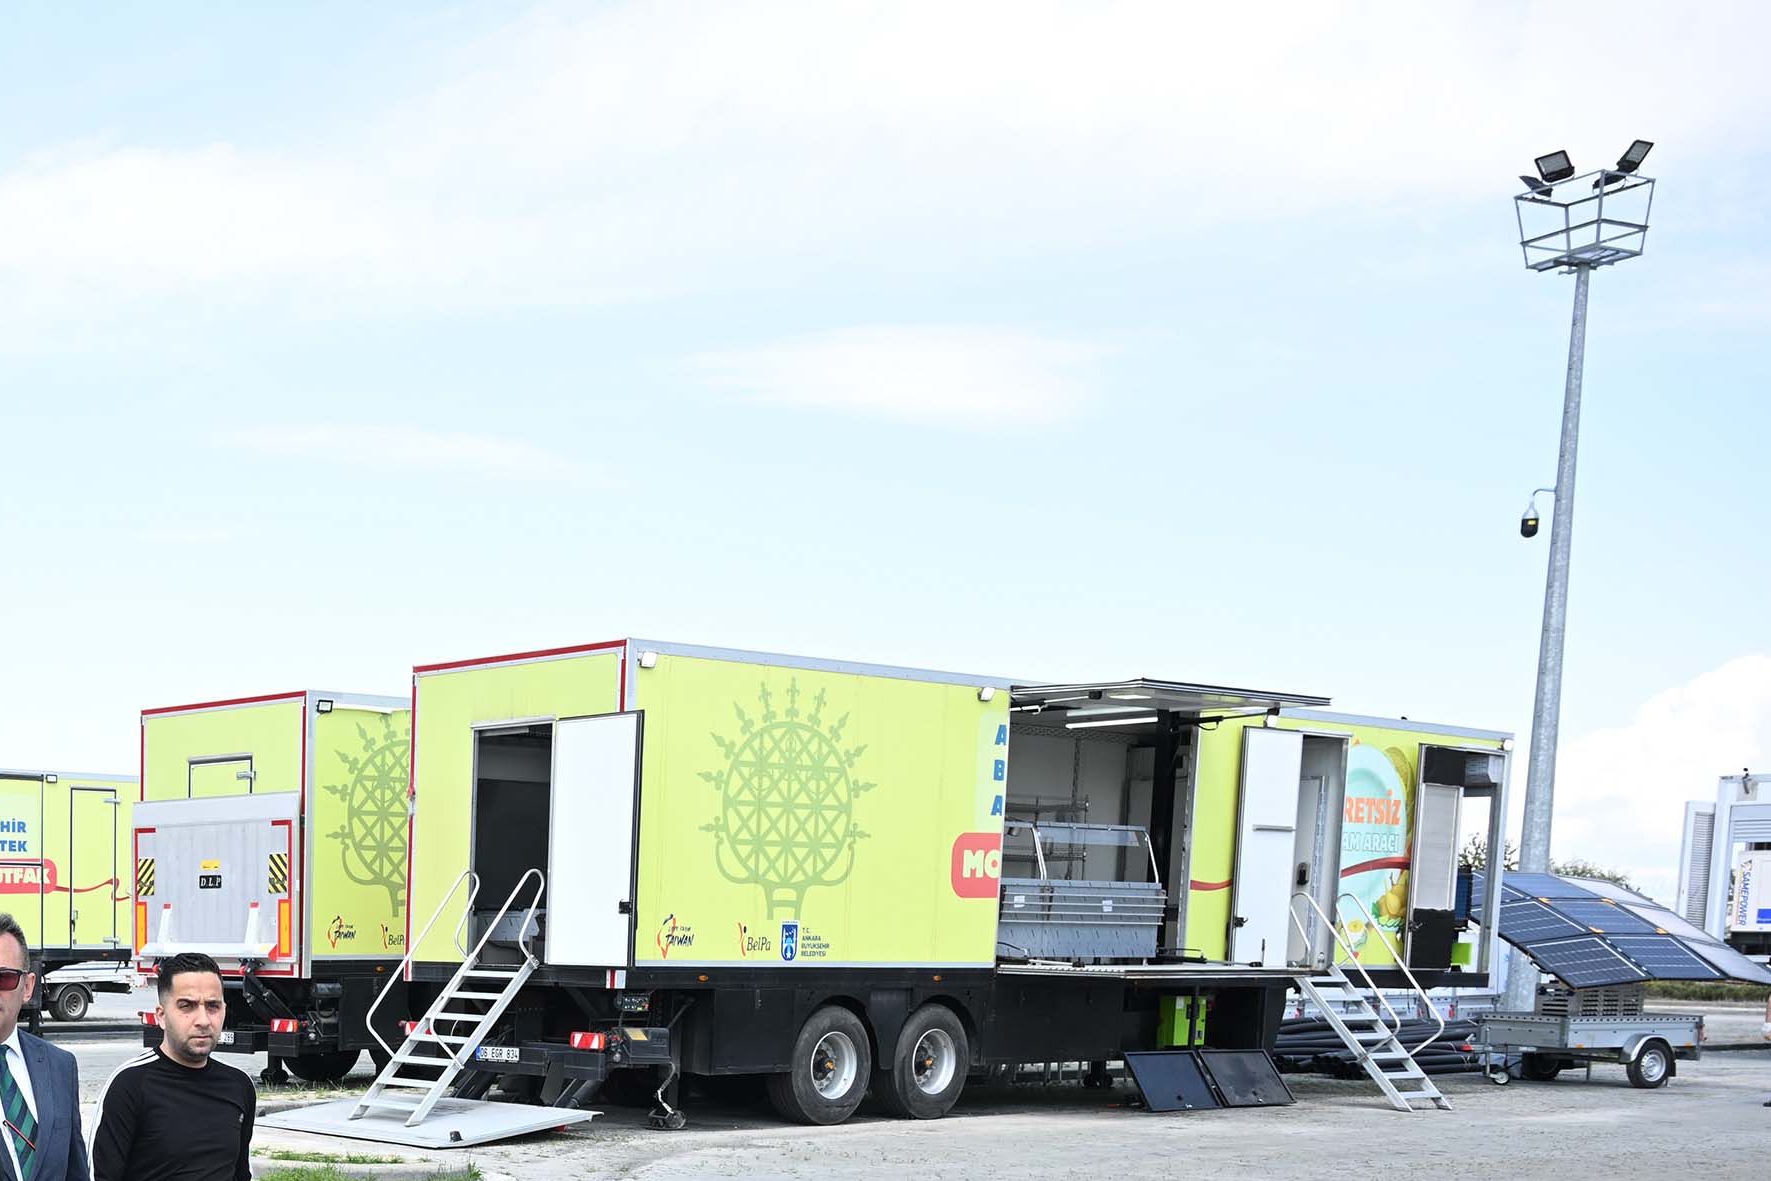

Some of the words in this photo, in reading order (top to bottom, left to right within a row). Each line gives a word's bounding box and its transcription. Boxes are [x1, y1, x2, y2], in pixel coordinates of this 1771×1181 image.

[1363, 832, 1400, 853] ARACI
[1739, 872, 1752, 926] SAMEPOWER
[747, 936, 771, 951] BelPa
